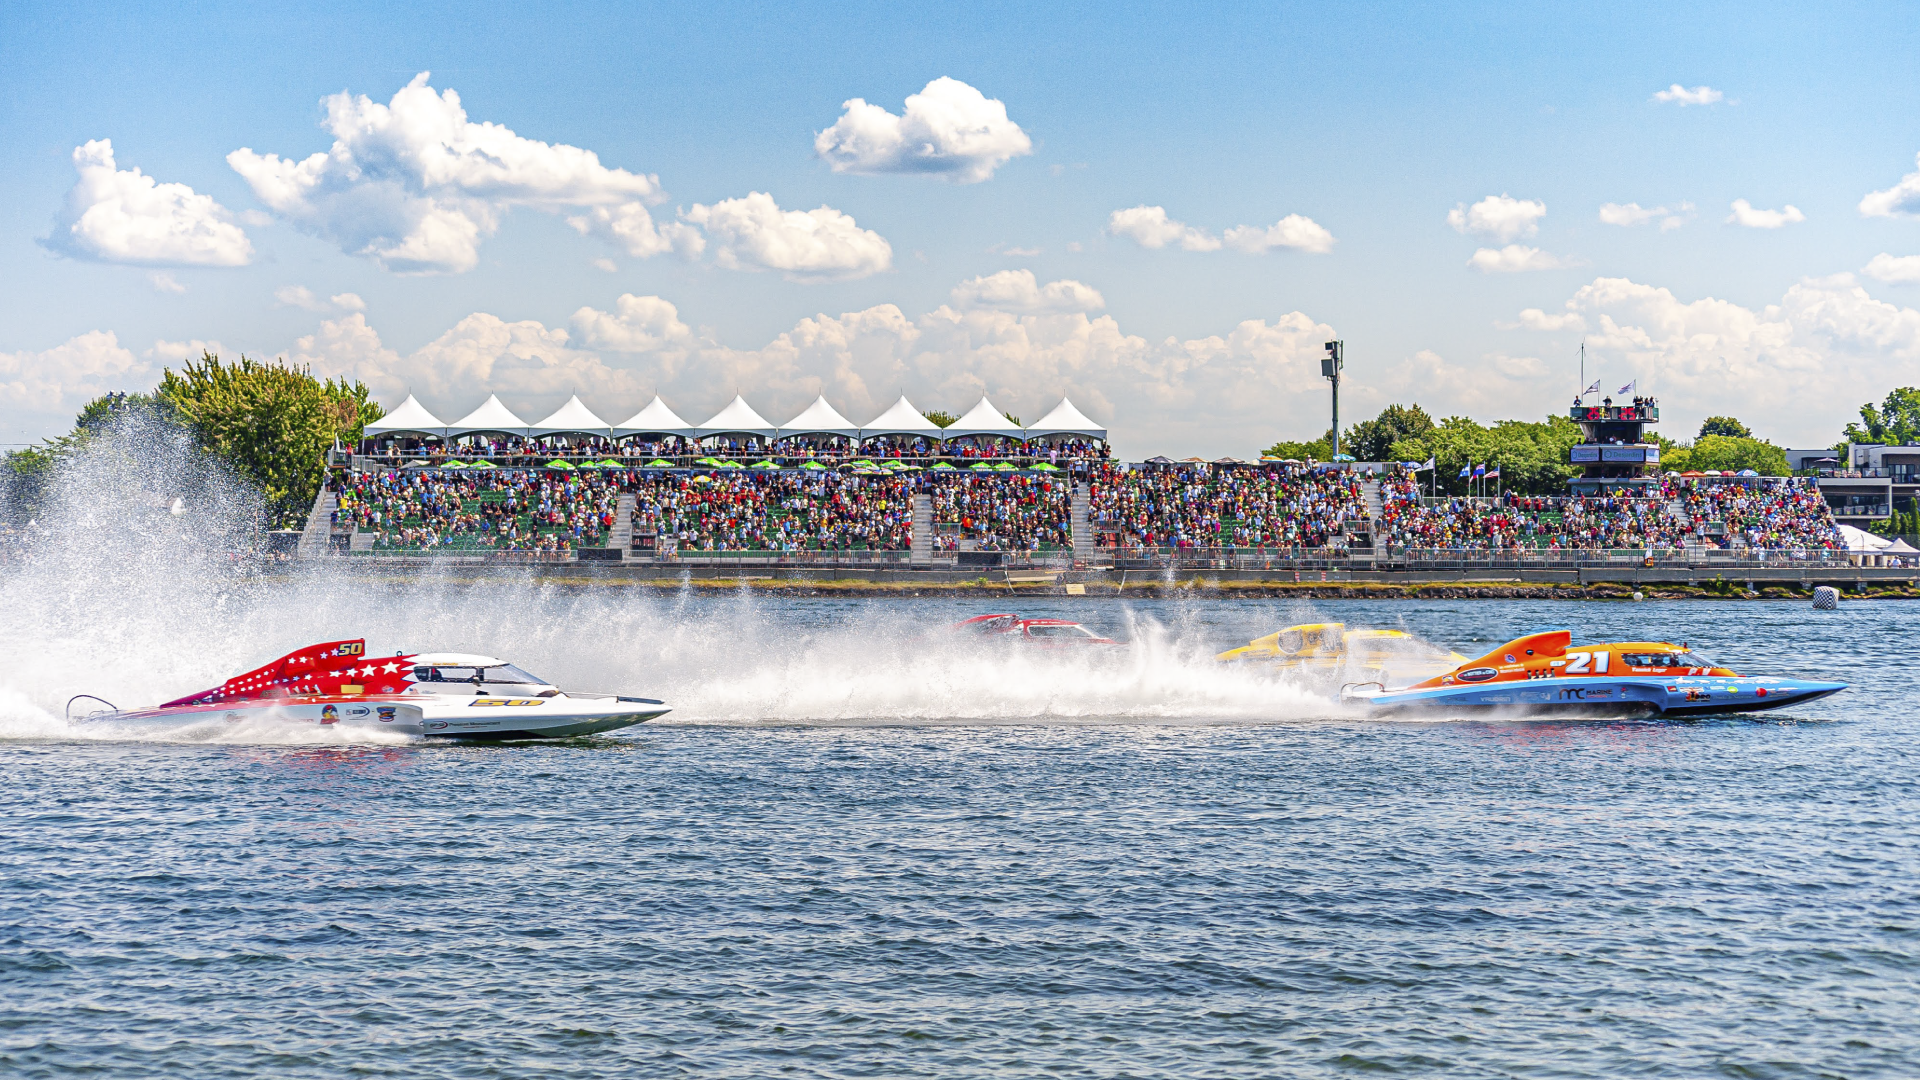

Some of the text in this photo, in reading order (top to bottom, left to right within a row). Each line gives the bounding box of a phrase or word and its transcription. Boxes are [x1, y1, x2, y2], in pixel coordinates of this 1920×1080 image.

[338, 643, 363, 656] 50
[1565, 651, 1610, 674] 21
[468, 699, 545, 707] 50
